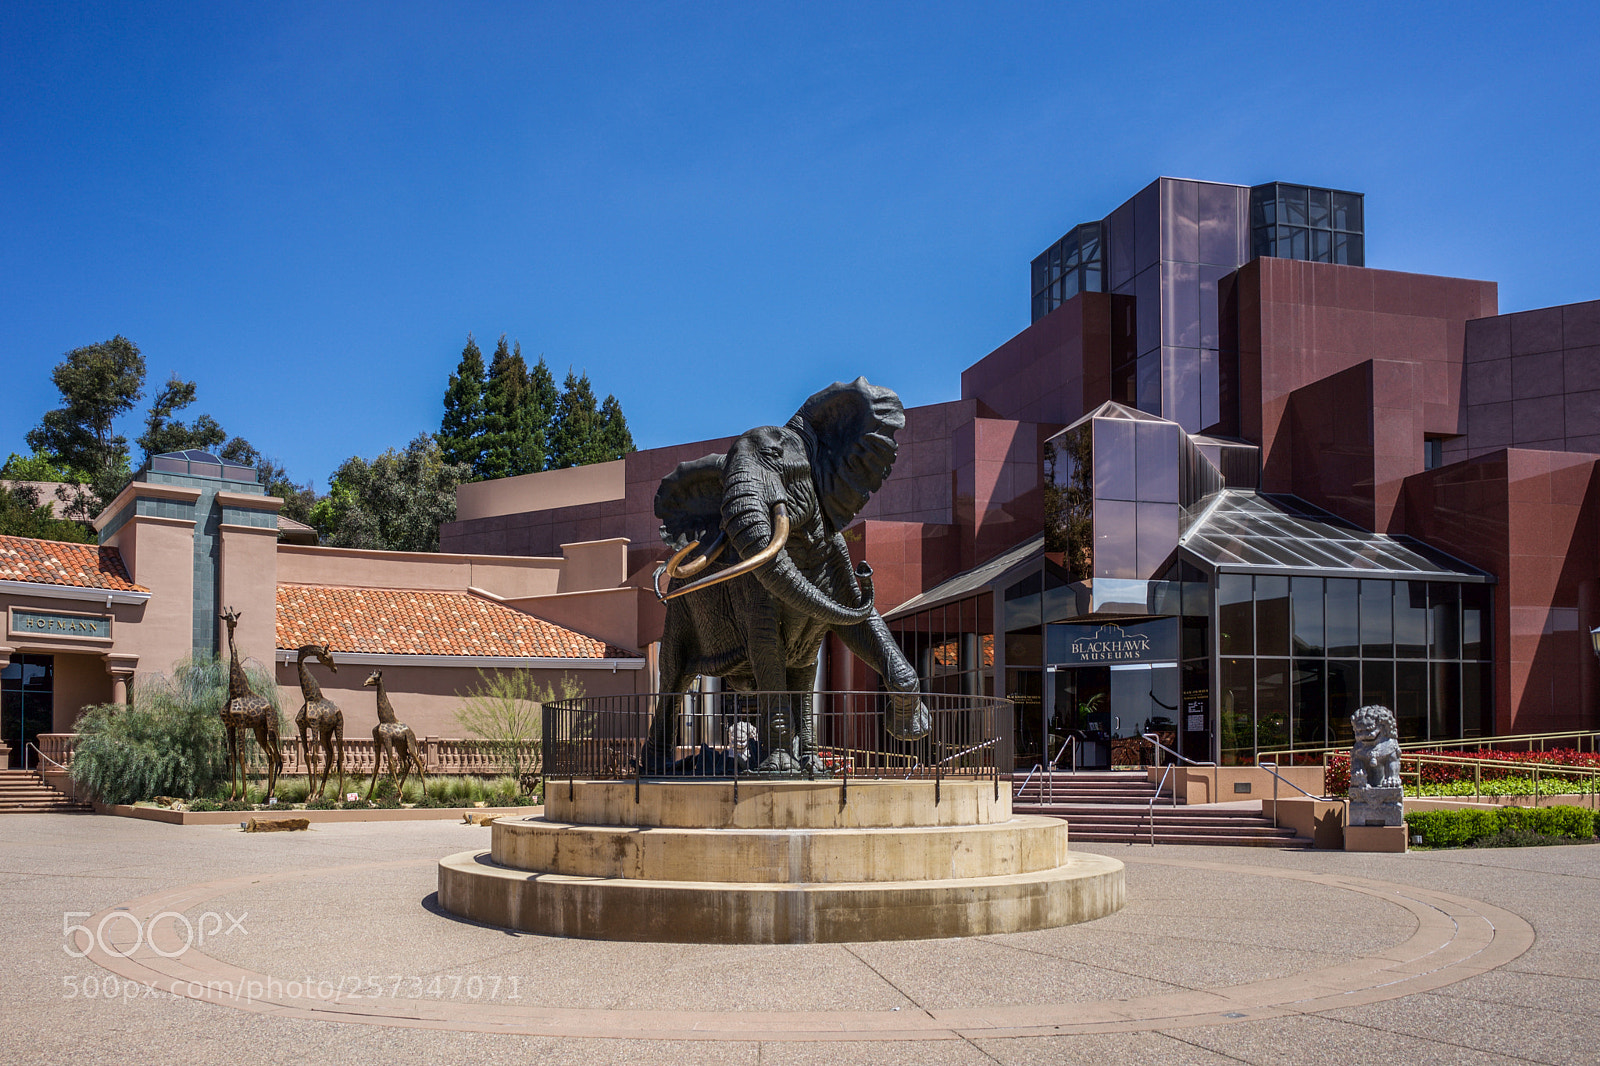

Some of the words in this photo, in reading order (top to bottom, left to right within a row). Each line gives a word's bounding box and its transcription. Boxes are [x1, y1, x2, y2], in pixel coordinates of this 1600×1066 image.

[26, 618, 97, 632] HOFMANN
[1072, 640, 1150, 654] BLACKHAWK
[1080, 651, 1140, 660] MUSEUMS
